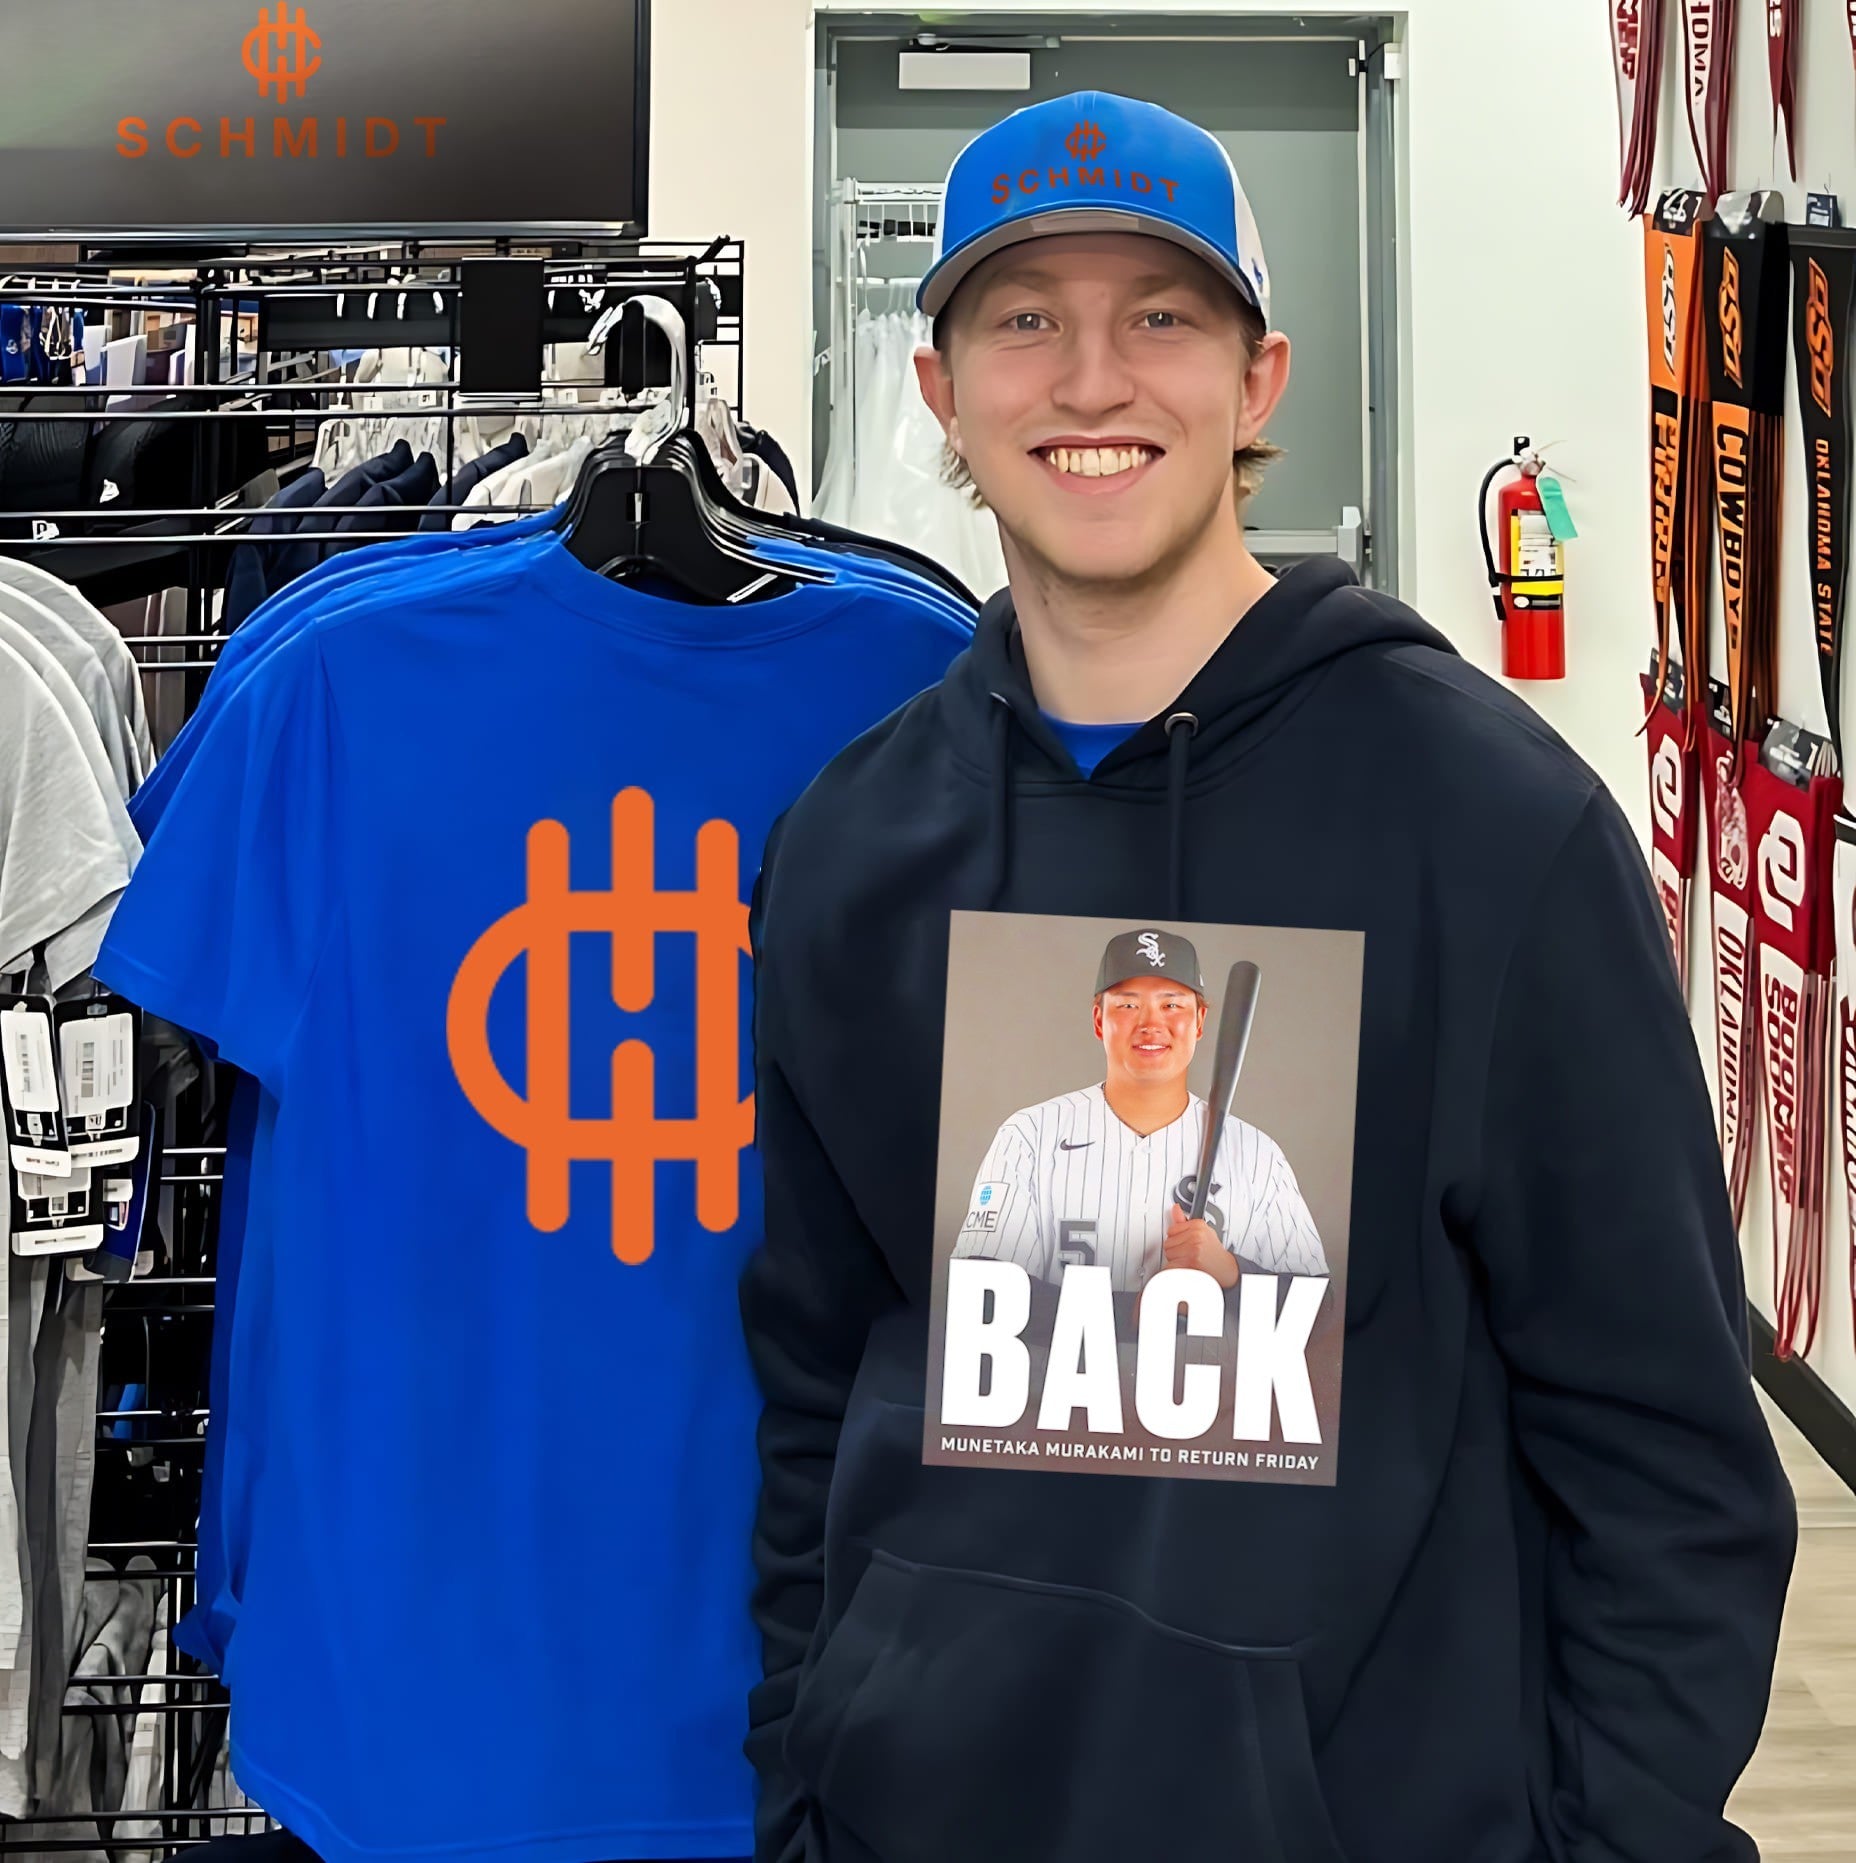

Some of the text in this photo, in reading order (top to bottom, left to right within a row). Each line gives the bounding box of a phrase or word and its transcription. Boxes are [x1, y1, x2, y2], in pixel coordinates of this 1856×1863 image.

[116, 117, 447, 159] SCHMIDT
[991, 167, 1179, 205] SCHMIDT
[1815, 438, 1834, 657] OKLAHOMA STATE
[1718, 926, 1745, 1144] OKLAHOMA
[965, 1209, 998, 1229] CME
[1060, 1220, 1096, 1267] 5
[941, 1258, 1330, 1444] BACK
[940, 1437, 1319, 1470] MUNETAKA MURAKAMI TO RETURN FRIDAY
